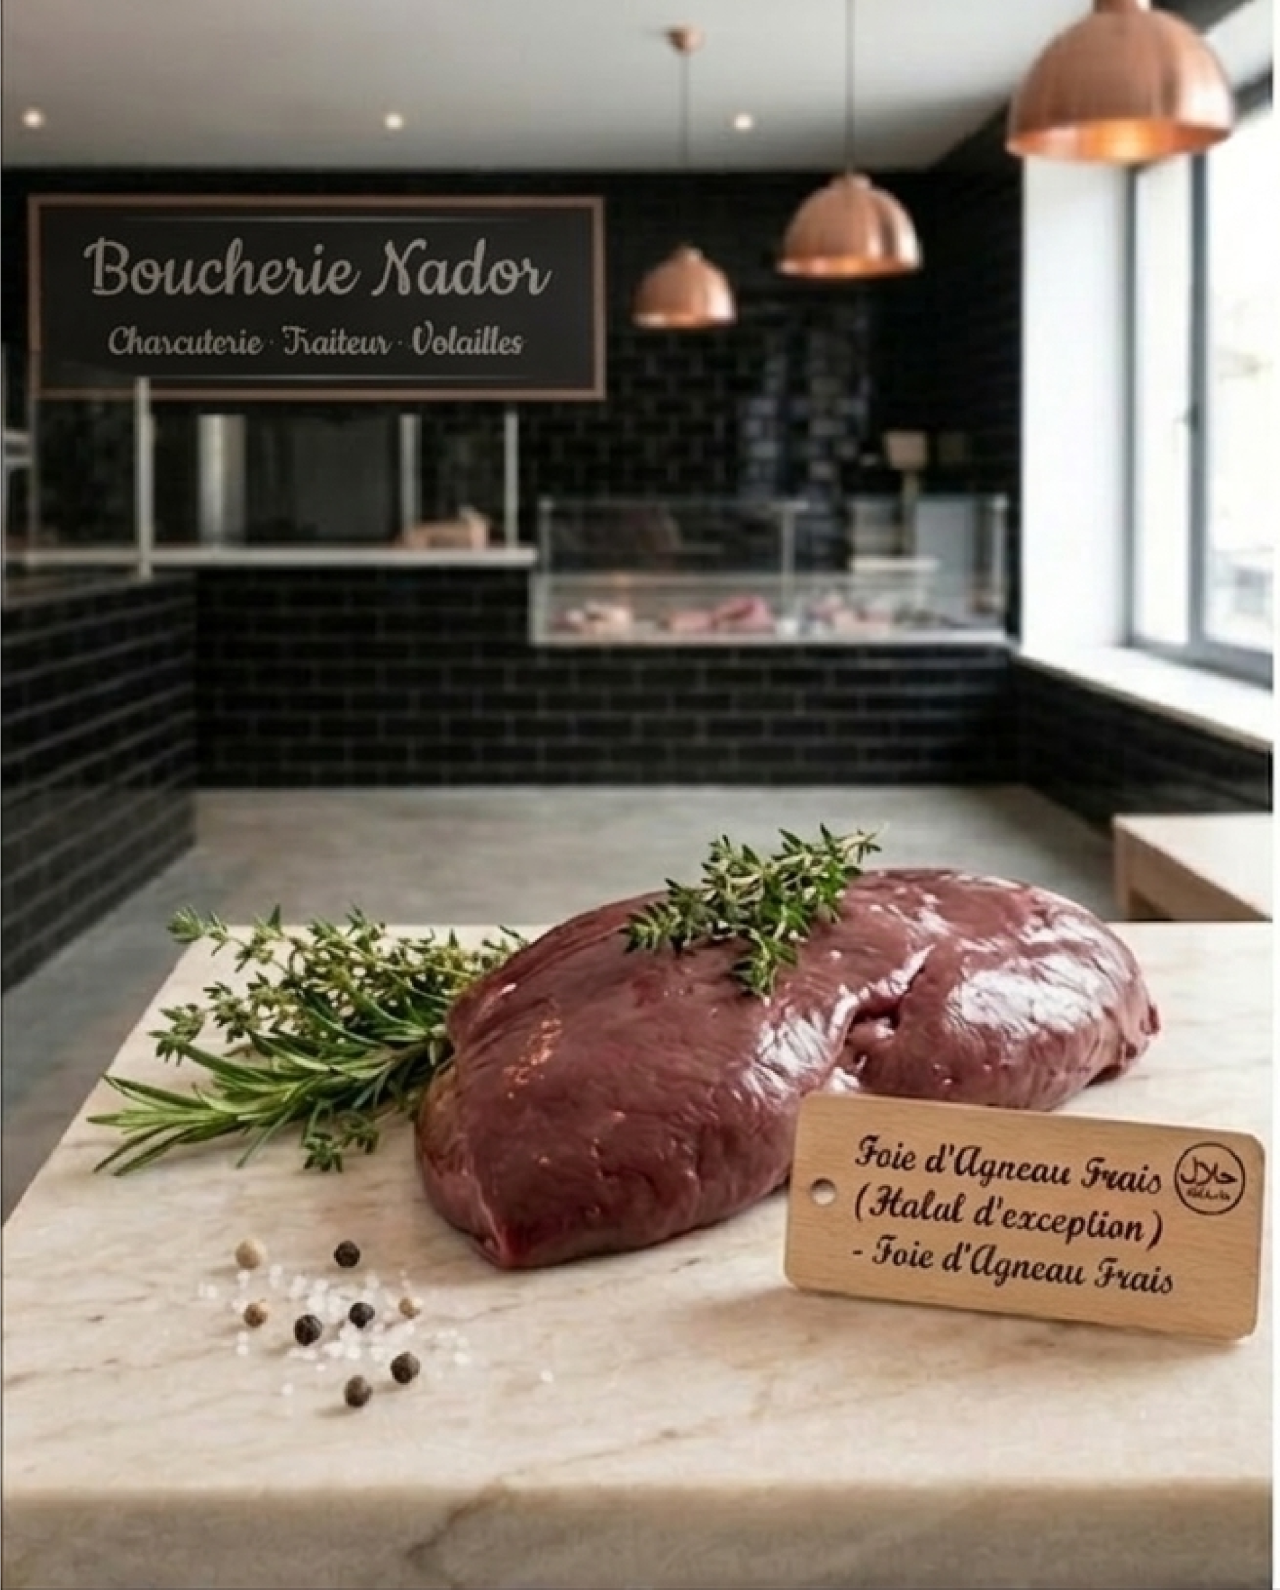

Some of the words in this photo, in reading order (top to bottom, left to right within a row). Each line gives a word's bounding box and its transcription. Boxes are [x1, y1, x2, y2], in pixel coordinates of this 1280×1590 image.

[83, 237, 360, 295] Boucherie
[371, 238, 552, 296] Nador
[108, 325, 263, 356] Charcuterie
[282, 325, 391, 356] Traiteur
[412, 320, 523, 356] Volailles
[854, 1135, 916, 1171] Foie
[924, 1144, 1071, 1188] d'Agneau
[1080, 1157, 1162, 1195] Frais
[854, 1182, 967, 1224] (Halal
[973, 1195, 1164, 1251] d'exception)
[872, 1234, 935, 1271] Foie
[941, 1242, 1086, 1288] d'Agneau
[1093, 1257, 1175, 1295] Frais
